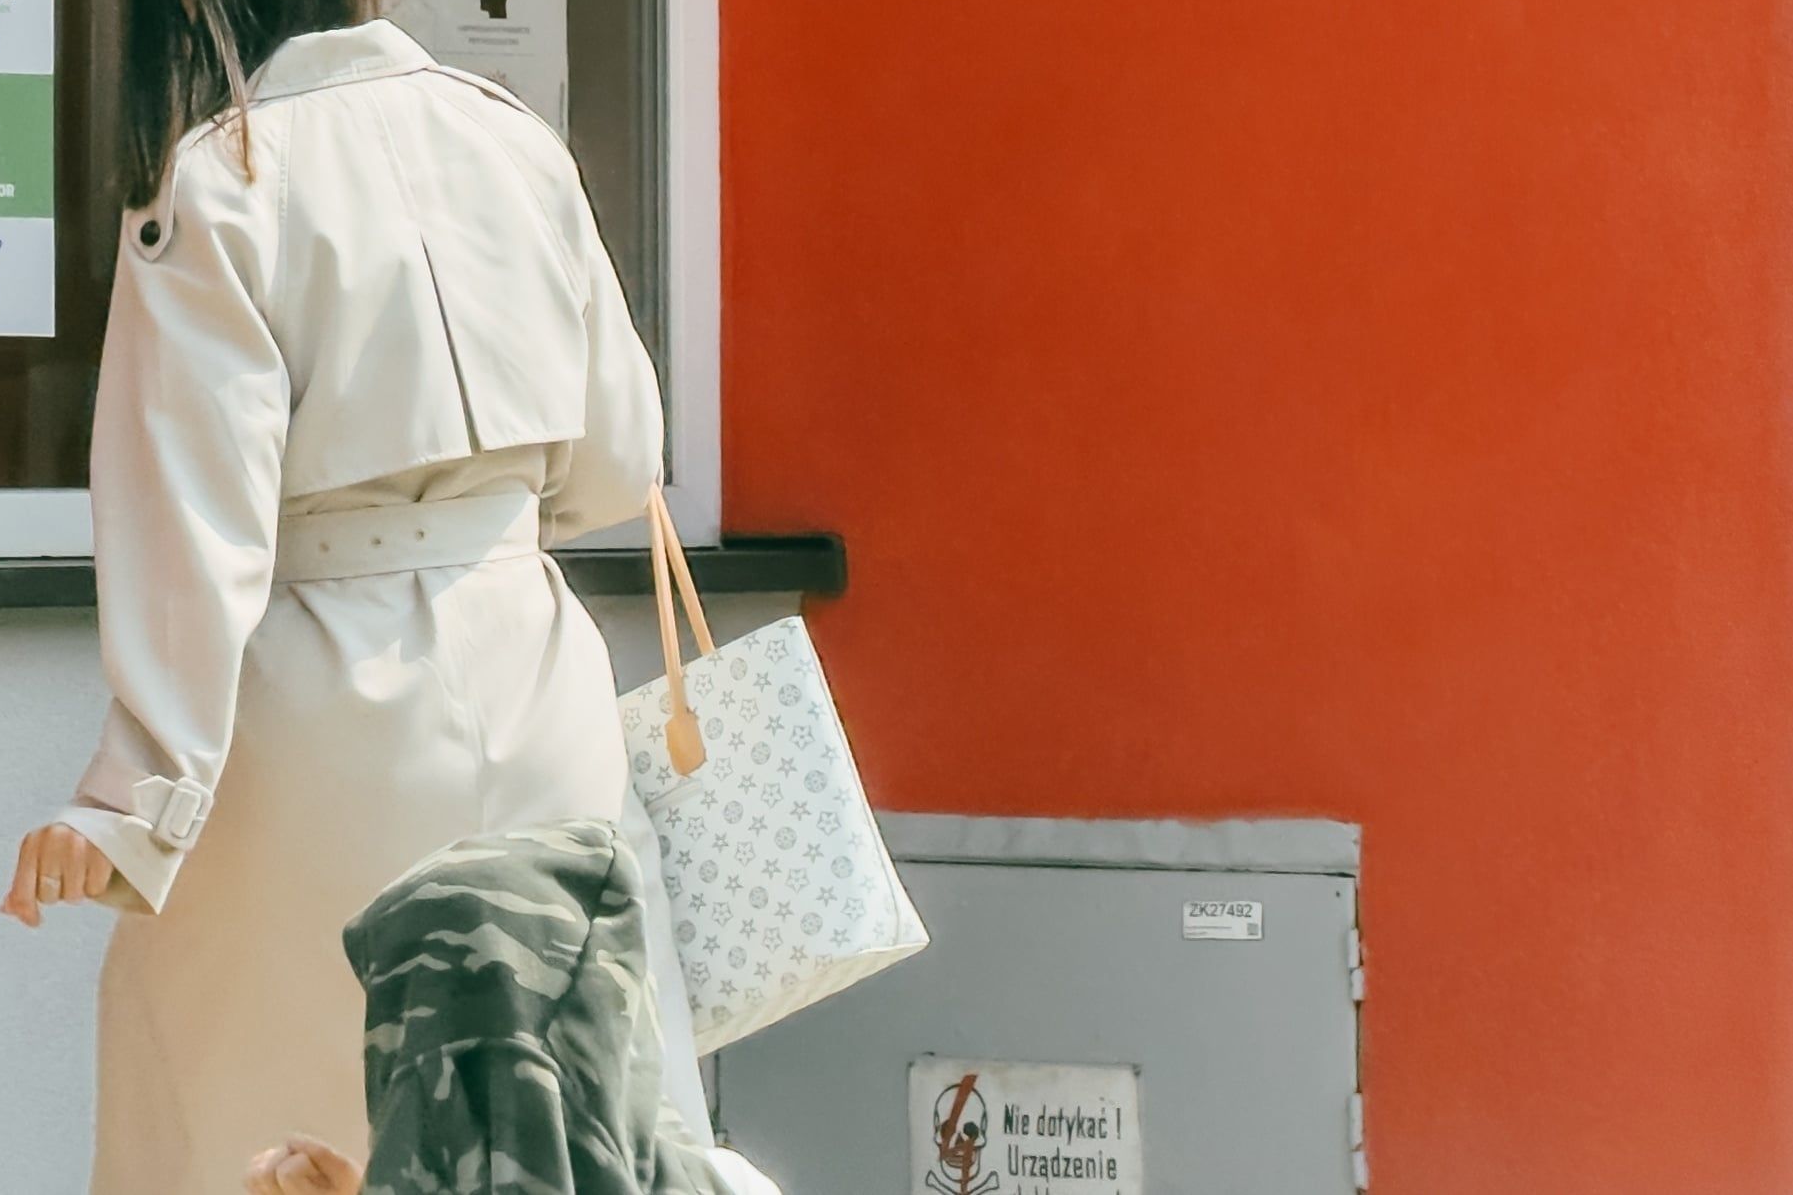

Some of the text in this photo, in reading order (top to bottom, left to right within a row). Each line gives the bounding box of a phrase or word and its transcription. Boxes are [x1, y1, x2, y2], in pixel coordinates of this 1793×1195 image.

[1004, 1103, 1030, 1135] Nie
[1036, 1104, 1108, 1145] dotykać
[1007, 1143, 1118, 1181] Urządzenie
